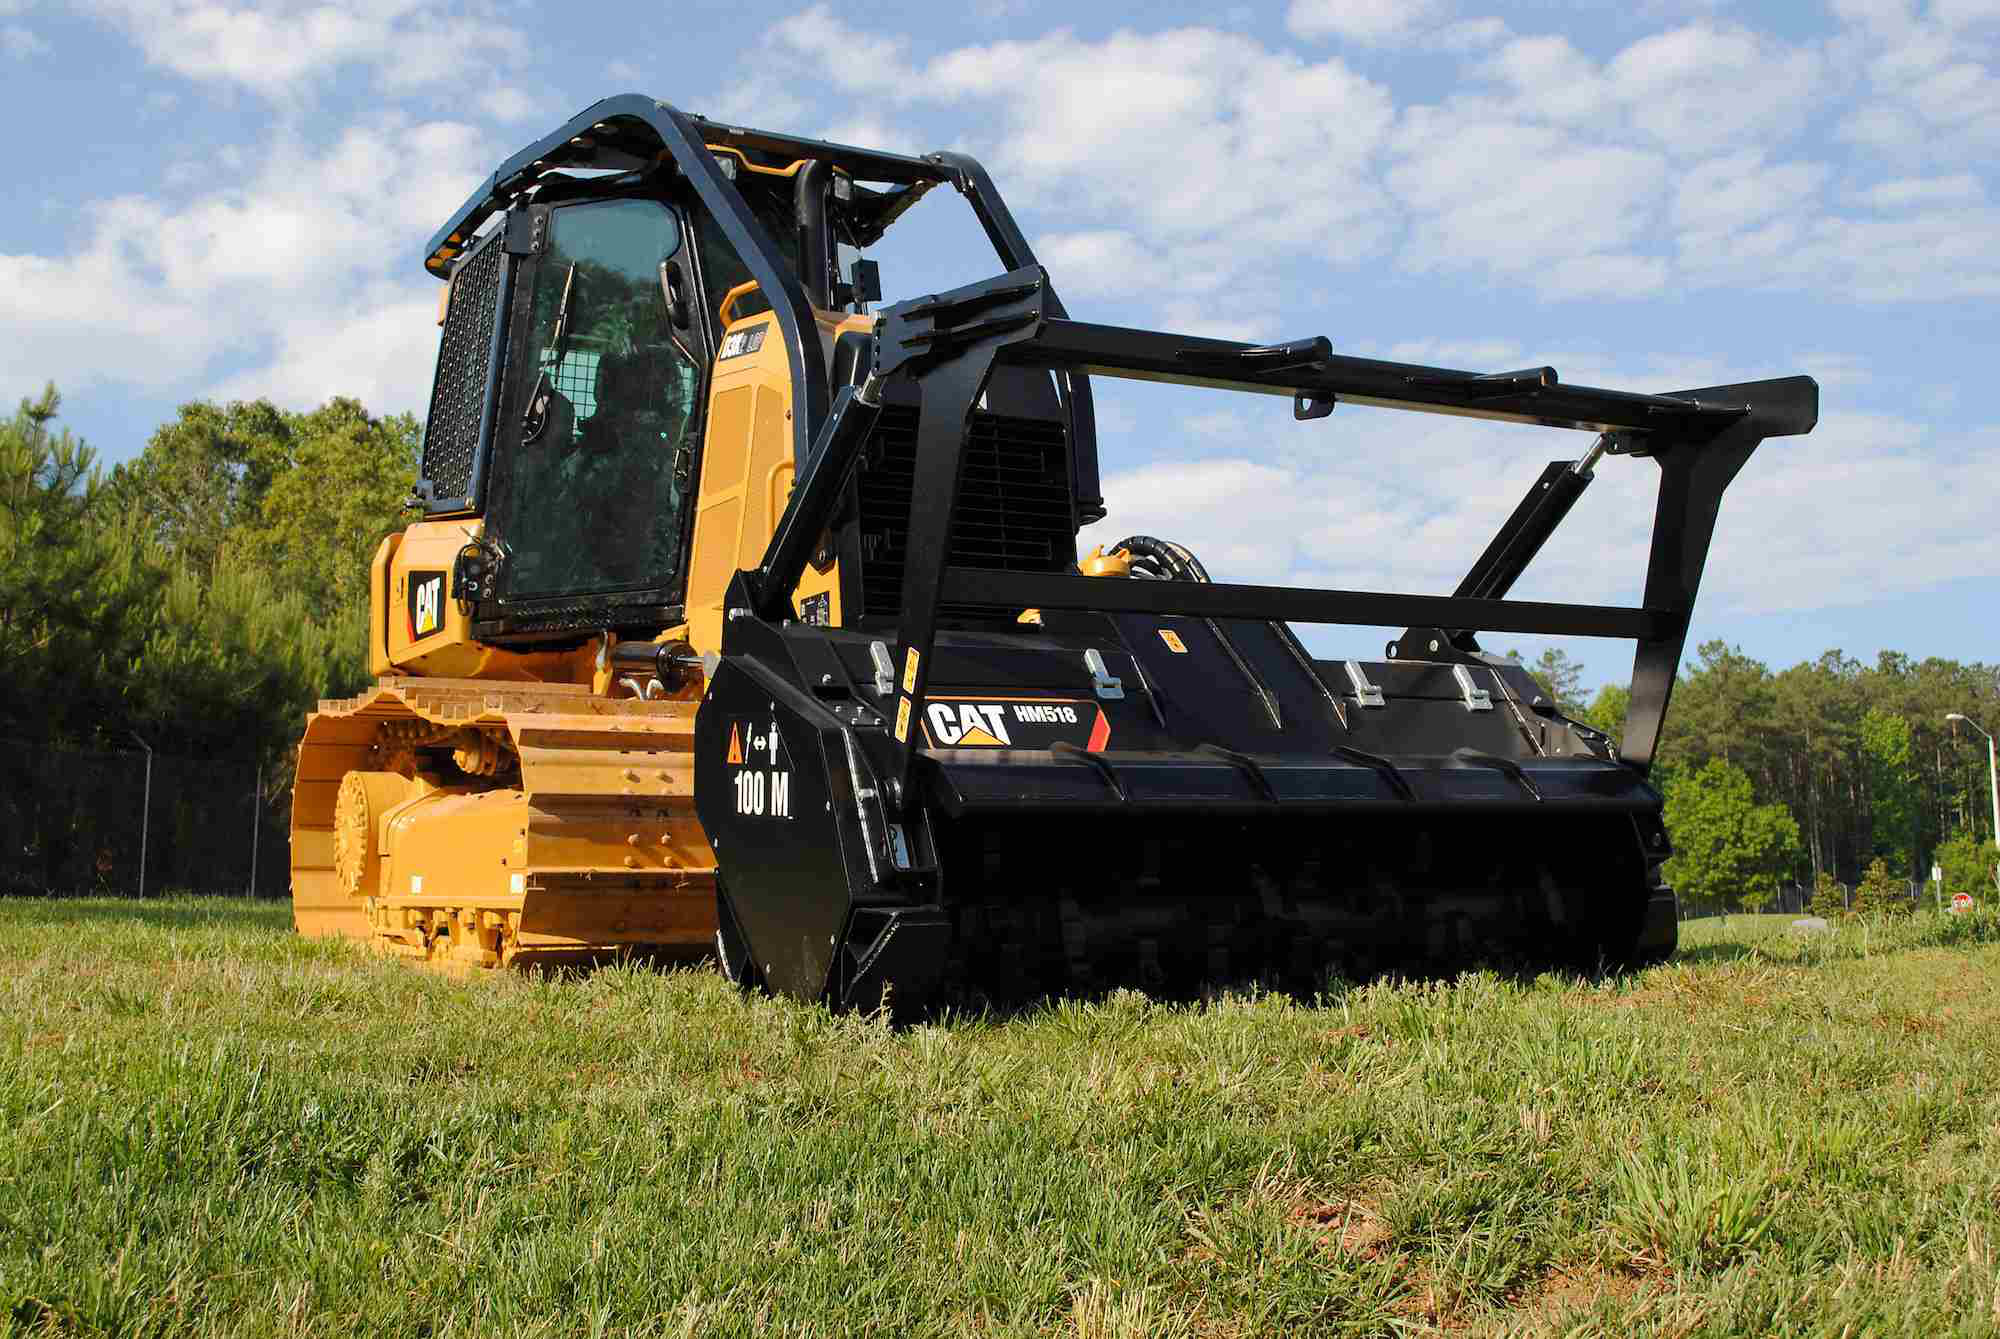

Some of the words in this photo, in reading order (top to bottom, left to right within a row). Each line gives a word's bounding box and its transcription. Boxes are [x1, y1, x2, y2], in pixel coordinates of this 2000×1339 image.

[416, 576, 440, 635] CAT
[927, 703, 1011, 745] CAT
[1013, 705, 1077, 723] HM518
[734, 770, 765, 816] 100
[771, 771, 789, 817] M
